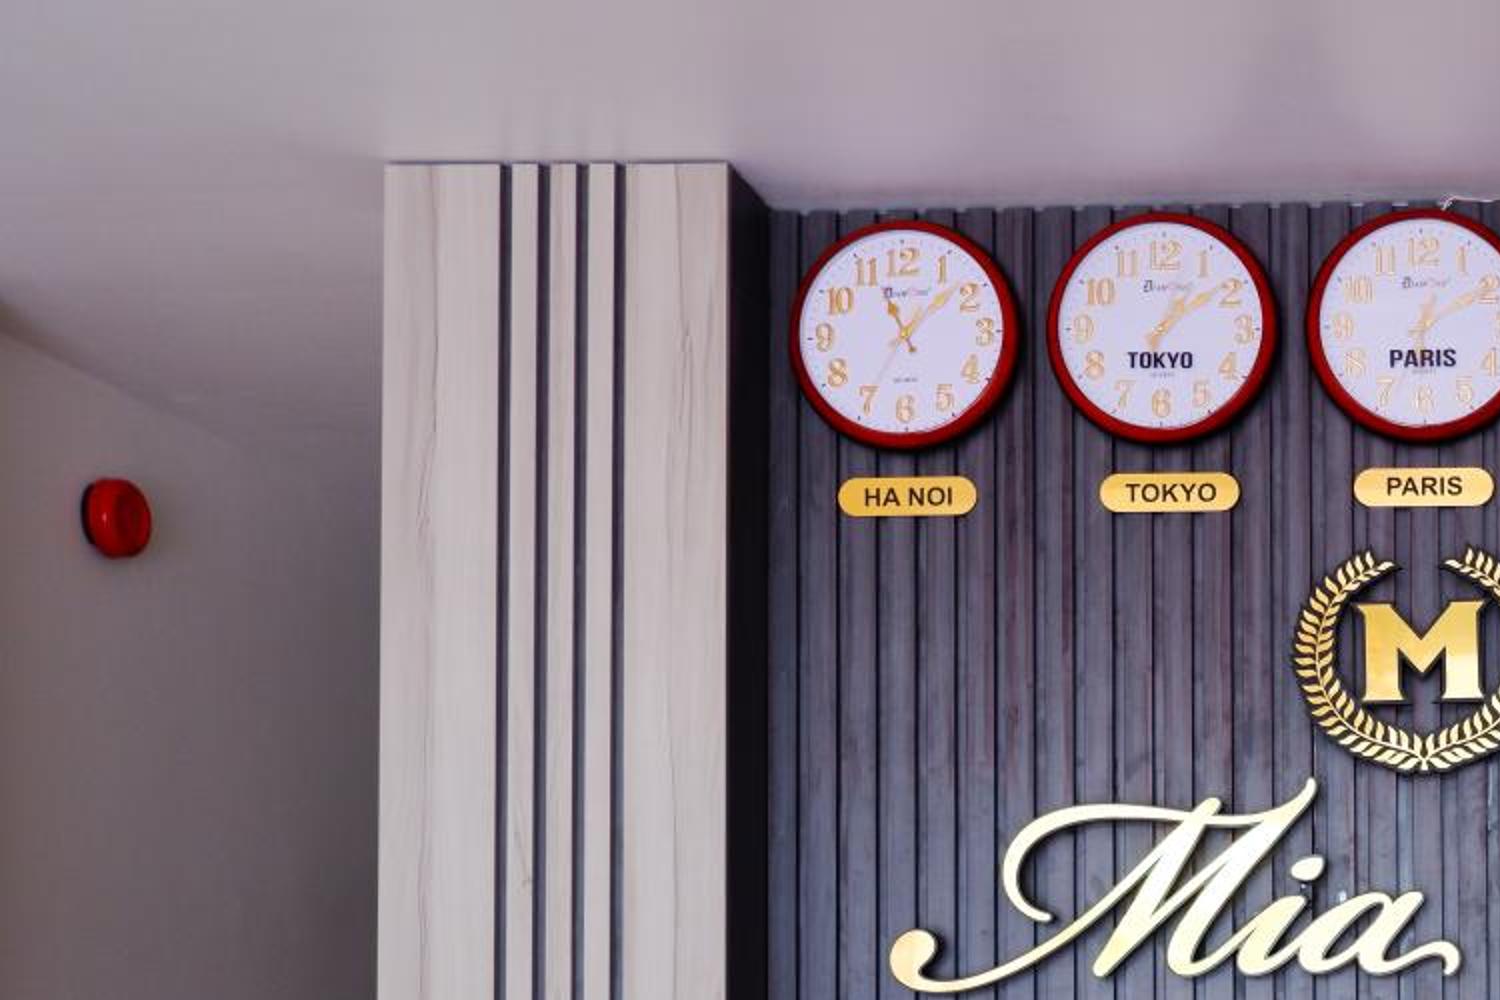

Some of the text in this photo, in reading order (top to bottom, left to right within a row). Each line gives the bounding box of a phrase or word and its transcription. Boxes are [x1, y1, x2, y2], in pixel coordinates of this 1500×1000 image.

[886, 248, 919, 277] 12
[1117, 249, 1138, 277] 11
[1149, 240, 1181, 270] 12
[1196, 249, 1209, 278] 1
[1375, 246, 1396, 276] 11
[1407, 238, 1440, 267] 12
[1456, 246, 1468, 274] 1
[854, 257, 878, 287] 11
[936, 255, 948, 284] 1
[827, 287, 854, 315] 10
[959, 283, 980, 313] 2
[1086, 278, 1115, 305] 10
[1219, 278, 1242, 306] 2
[1344, 275, 1374, 303] 10
[1478, 275, 1500, 303] 2
[815, 323, 835, 352] 9
[976, 318, 994, 346] 3
[1074, 315, 1094, 344] 9
[1234, 315, 1254, 344] 3
[1334, 311, 1354, 340] 9
[827, 358, 848, 387] 8
[961, 354, 980, 384] 4
[1084, 351, 1104, 379] 8
[1128, 352, 1193, 369] TOKYO
[1219, 352, 1237, 379] 4
[1344, 349, 1367, 376] 8
[1389, 349, 1456, 368] PARIS
[1481, 348, 1499, 377] 4
[859, 385, 879, 415] 7
[936, 384, 954, 412] 5
[1114, 380, 1135, 408] 7
[1152, 388, 1171, 417] 6
[1192, 380, 1211, 407] 5
[1376, 378, 1396, 407] 7
[1415, 385, 1435, 414] 6
[1456, 376, 1474, 403] 5
[896, 395, 915, 423] 6
[864, 487, 952, 507] HA NOI
[1125, 484, 1216, 503] TOKYO
[1387, 477, 1462, 496] PARIS
[1356, 600, 1486, 703] M
[889, 776, 1460, 995] Mia
